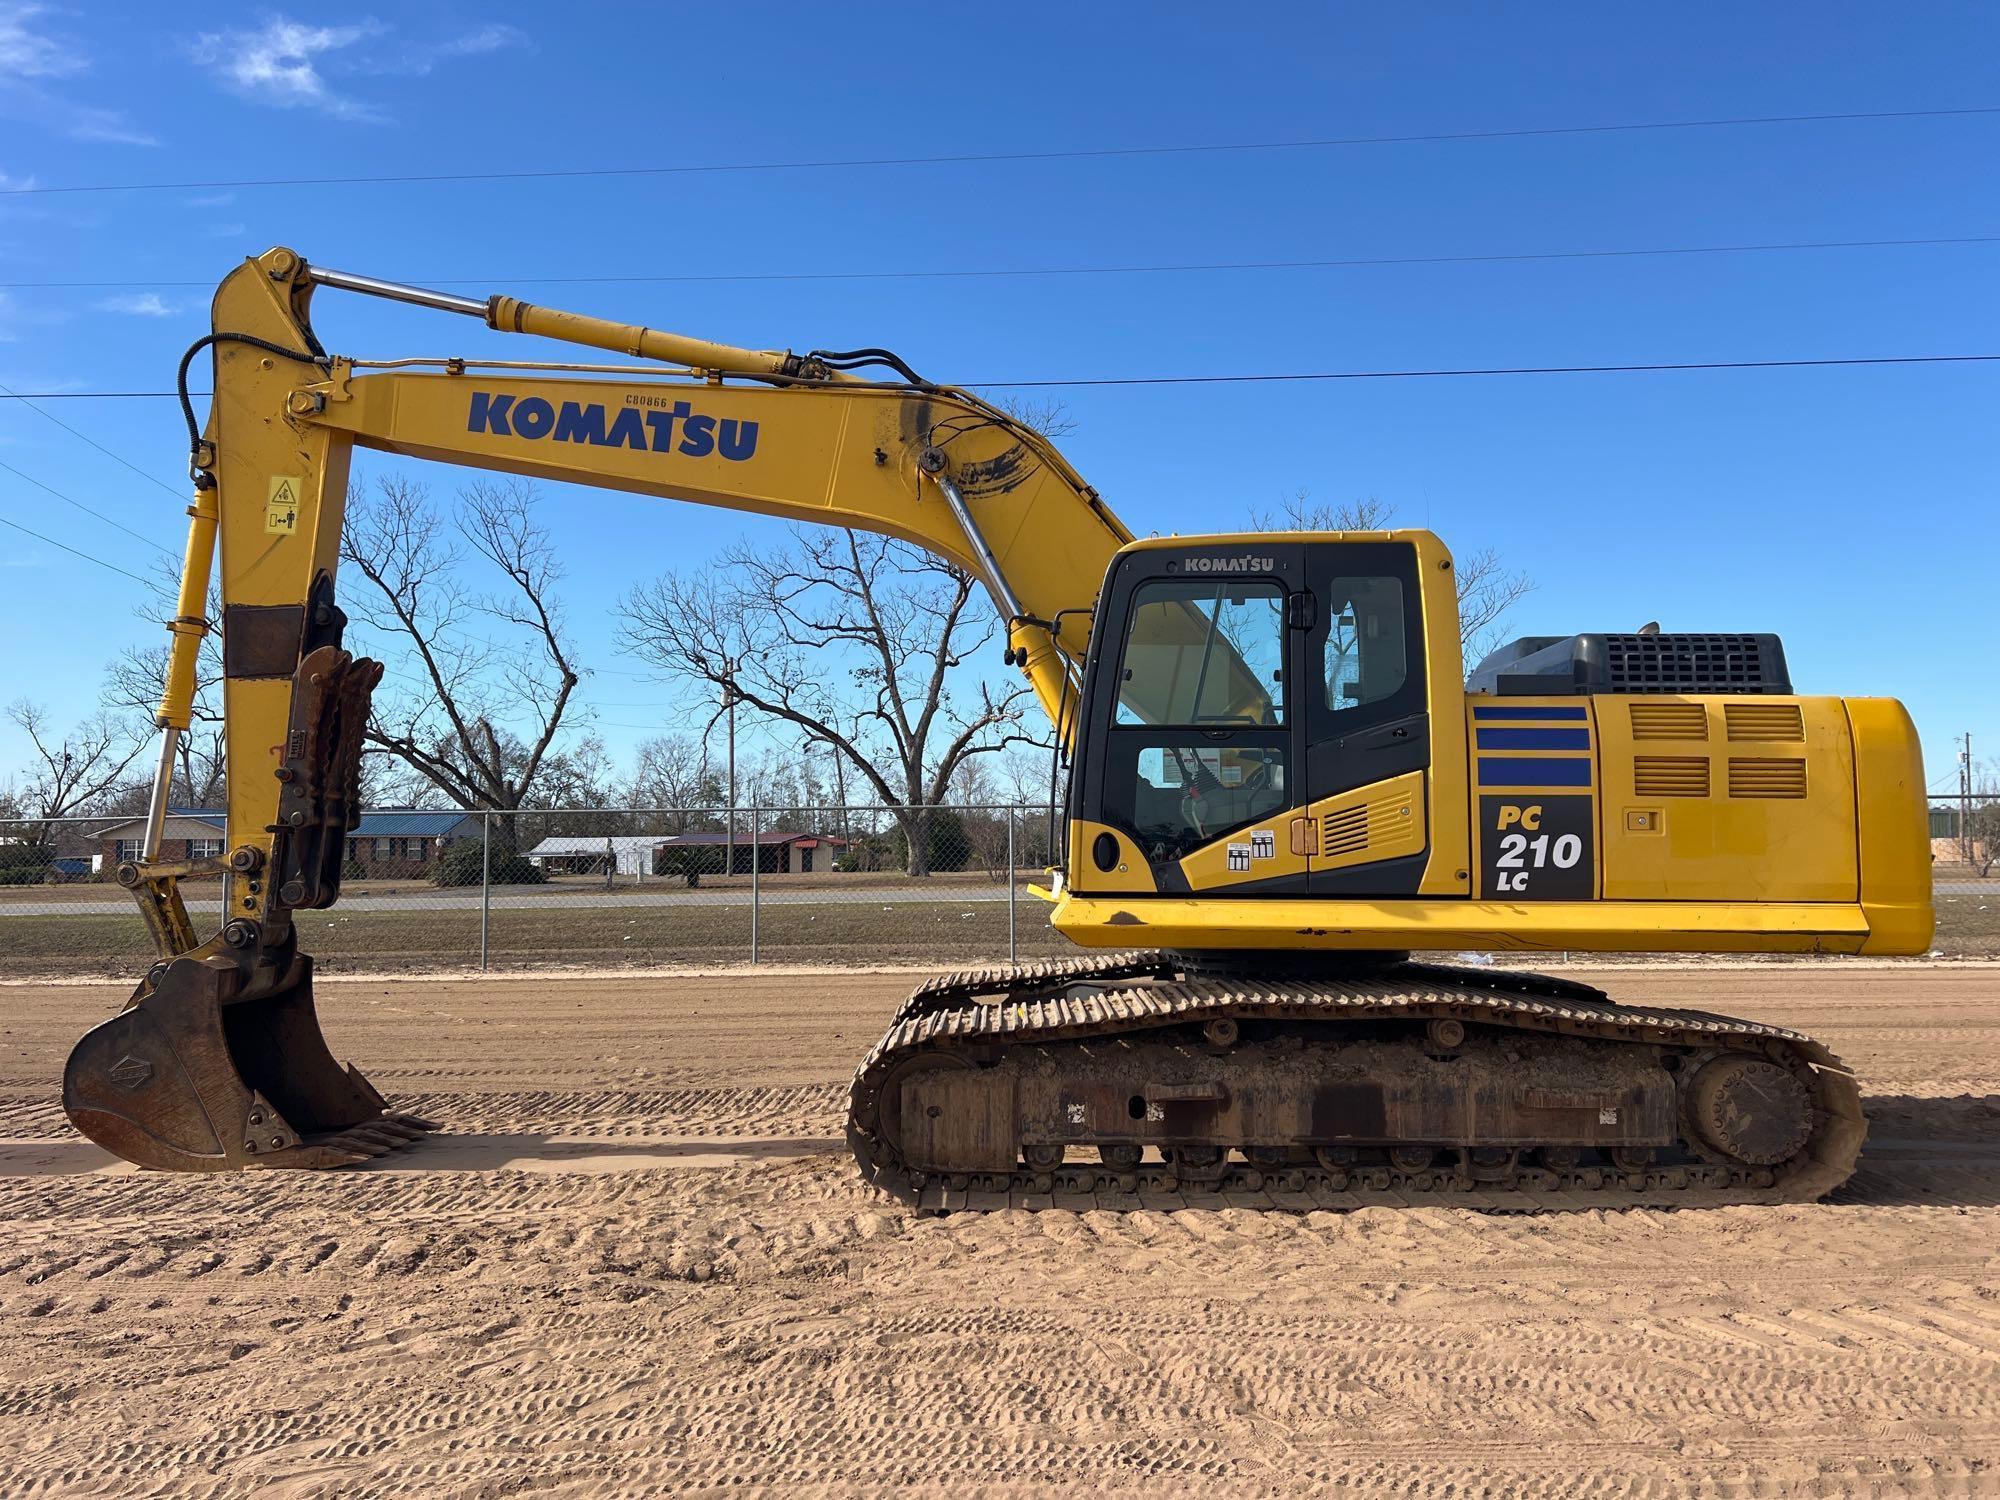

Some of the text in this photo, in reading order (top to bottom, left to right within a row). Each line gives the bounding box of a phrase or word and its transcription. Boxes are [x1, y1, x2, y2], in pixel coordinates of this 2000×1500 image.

[626, 394, 668, 408] C80866
[467, 391, 759, 461] KOMATSU
[1185, 554, 1274, 572] KOMATSU
[1497, 805, 1543, 831] PC
[1496, 833, 1582, 869] 210
[1496, 871, 1530, 891] LC
